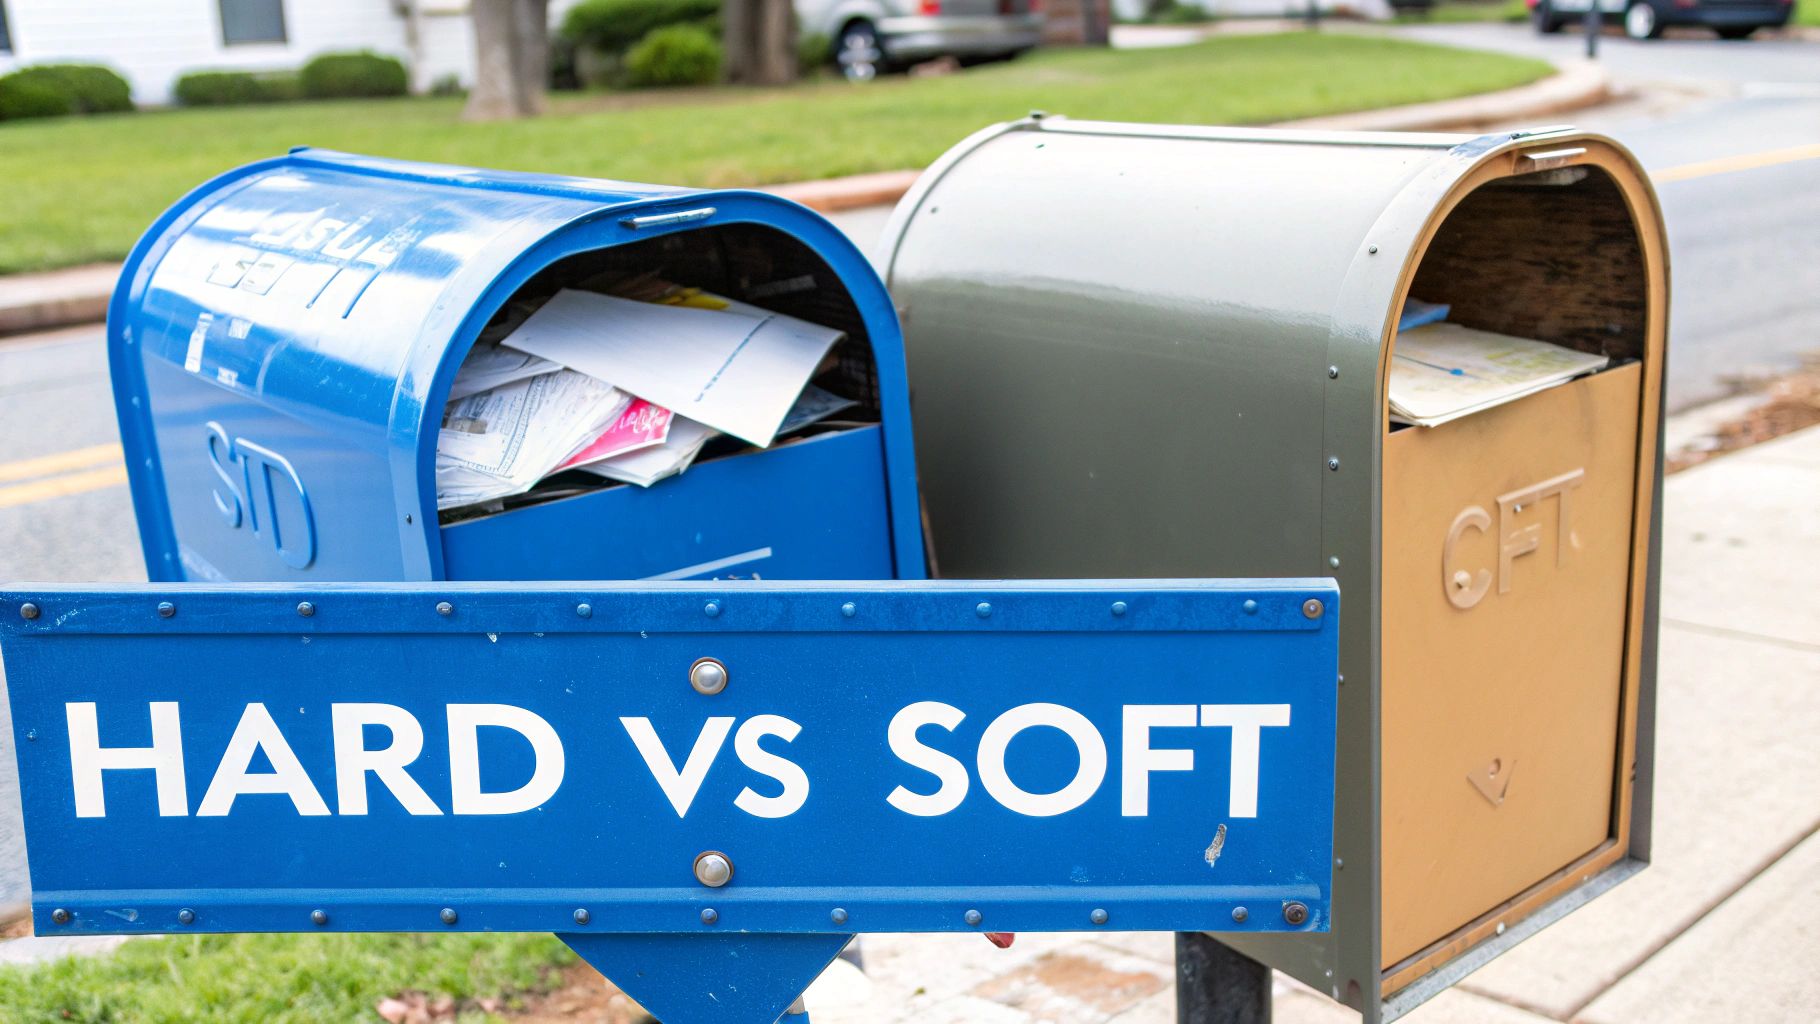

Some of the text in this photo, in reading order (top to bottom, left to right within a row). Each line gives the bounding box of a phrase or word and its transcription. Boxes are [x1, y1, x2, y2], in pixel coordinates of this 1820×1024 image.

[66, 701, 1291, 819] HARD VS SOFT
